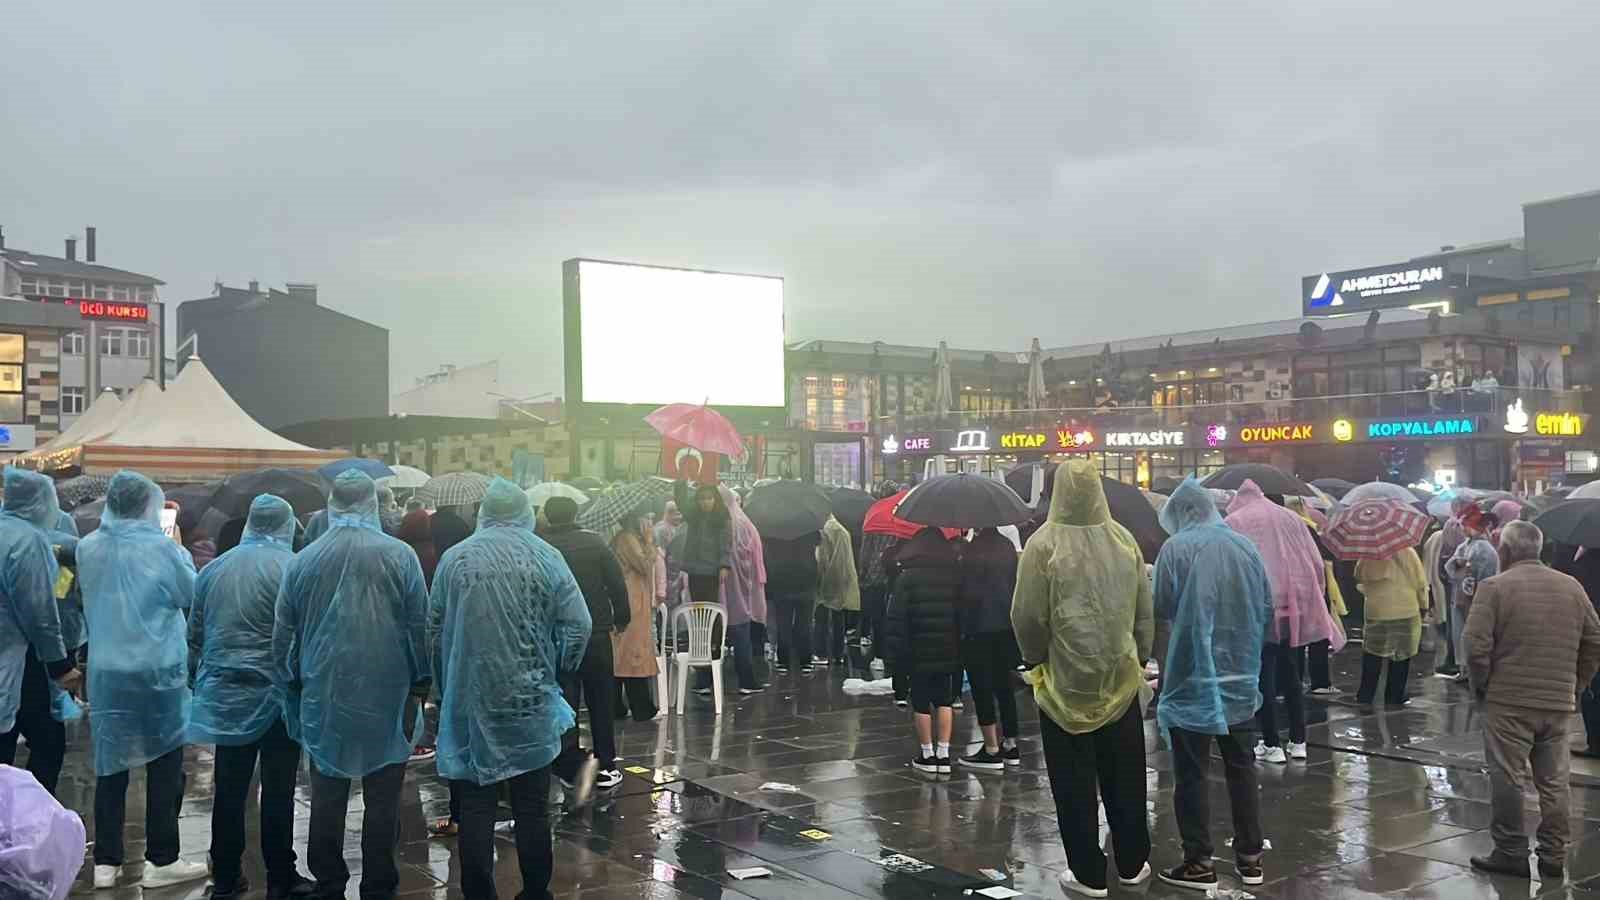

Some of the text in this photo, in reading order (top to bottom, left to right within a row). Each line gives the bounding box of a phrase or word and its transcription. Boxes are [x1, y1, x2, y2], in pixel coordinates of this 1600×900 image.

[107, 304, 146, 318] KURSU
[1368, 418, 1473, 437] KOPYALAMA
[1536, 412, 1582, 435] emin
[1001, 432, 1046, 448] KİTAP
[1105, 430, 1184, 447] KIRTASİYE
[1240, 425, 1313, 442] OYUNCAK
[904, 438, 931, 449] CAFE
